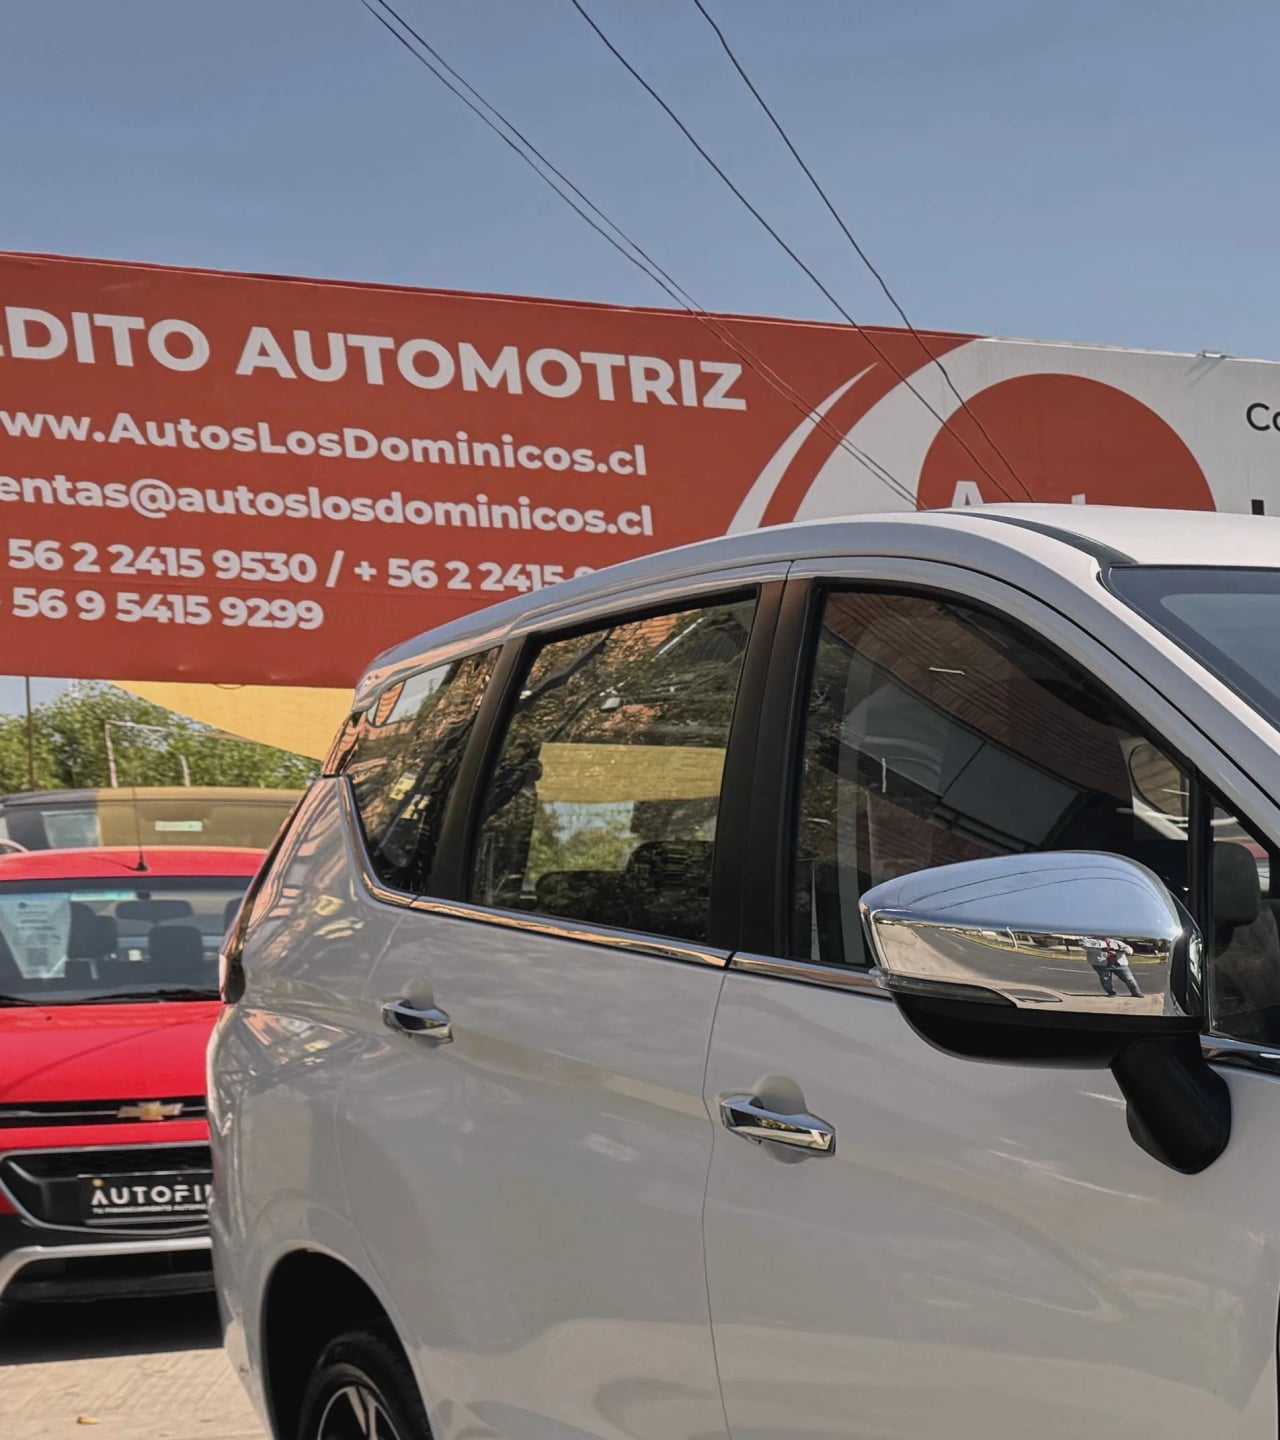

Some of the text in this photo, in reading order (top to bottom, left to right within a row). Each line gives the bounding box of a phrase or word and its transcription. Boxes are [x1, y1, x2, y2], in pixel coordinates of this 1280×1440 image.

[0, 307, 746, 410] DITO AUTOMOTRIZ
[8, 538, 63, 571] 56
[70, 541, 101, 573] 2
[107, 544, 205, 578] 2415
[212, 549, 317, 583] 9530
[387, 557, 438, 589] 56
[444, 560, 472, 590] 2
[478, 562, 564, 592] 2415
[13, 587, 323, 630] 56 9 5415 9299
